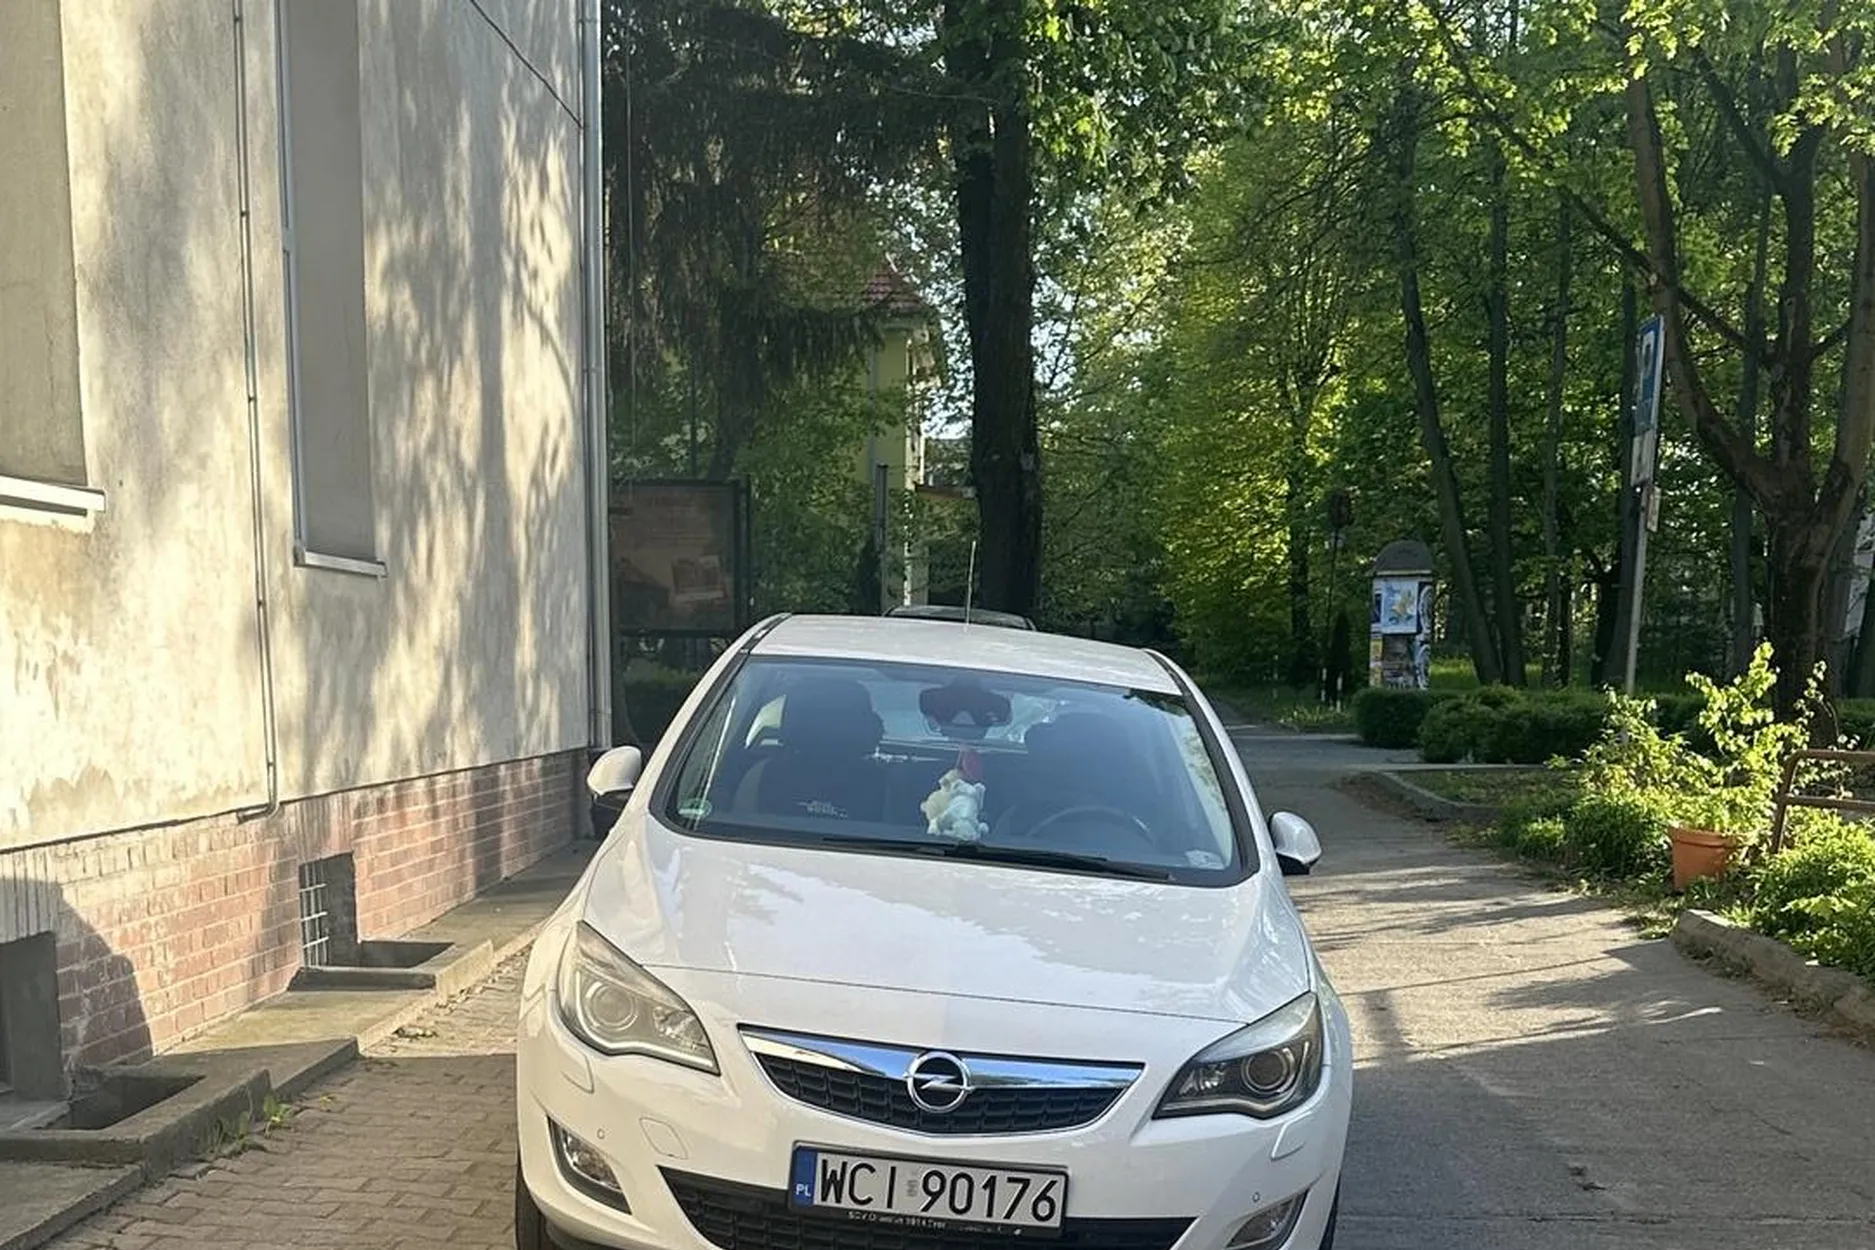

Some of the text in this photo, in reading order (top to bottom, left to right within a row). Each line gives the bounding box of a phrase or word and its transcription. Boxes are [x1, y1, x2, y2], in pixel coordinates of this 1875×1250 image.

[796, 1184, 811, 1197] PL
[820, 1158, 1058, 1222] WCI 90176
